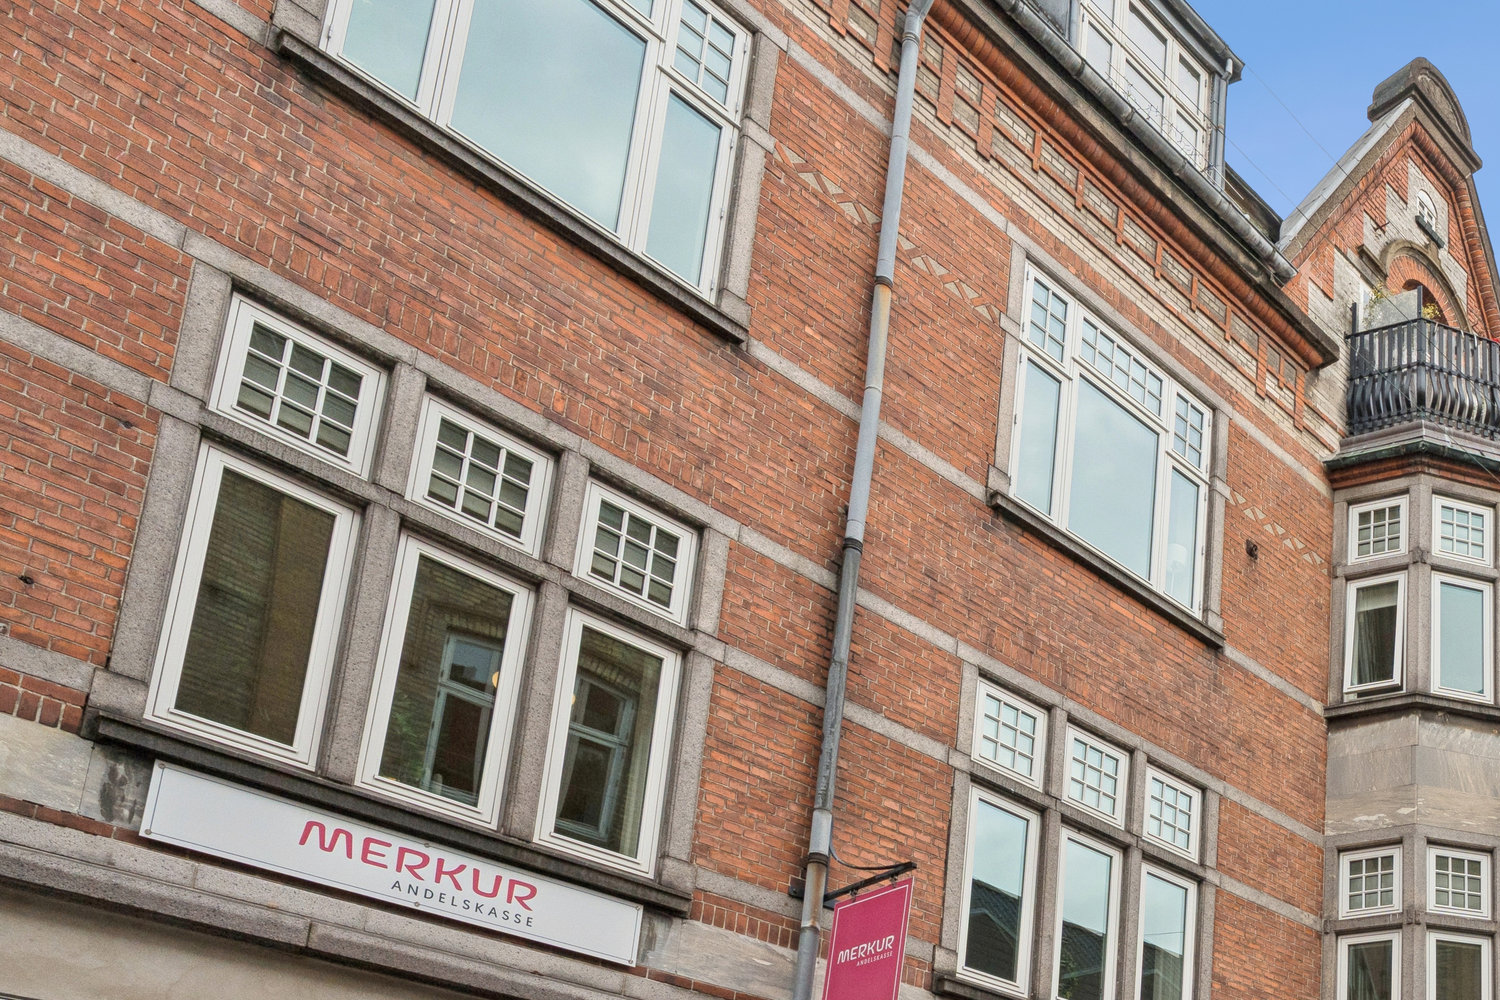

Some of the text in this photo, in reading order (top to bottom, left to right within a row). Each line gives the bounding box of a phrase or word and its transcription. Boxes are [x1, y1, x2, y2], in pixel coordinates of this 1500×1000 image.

[298, 820, 538, 912] MERKUR
[391, 880, 534, 928] ANDELSKASSE
[836, 935, 895, 965] MERKUR
[856, 950, 893, 967] ANDELSKASSE
